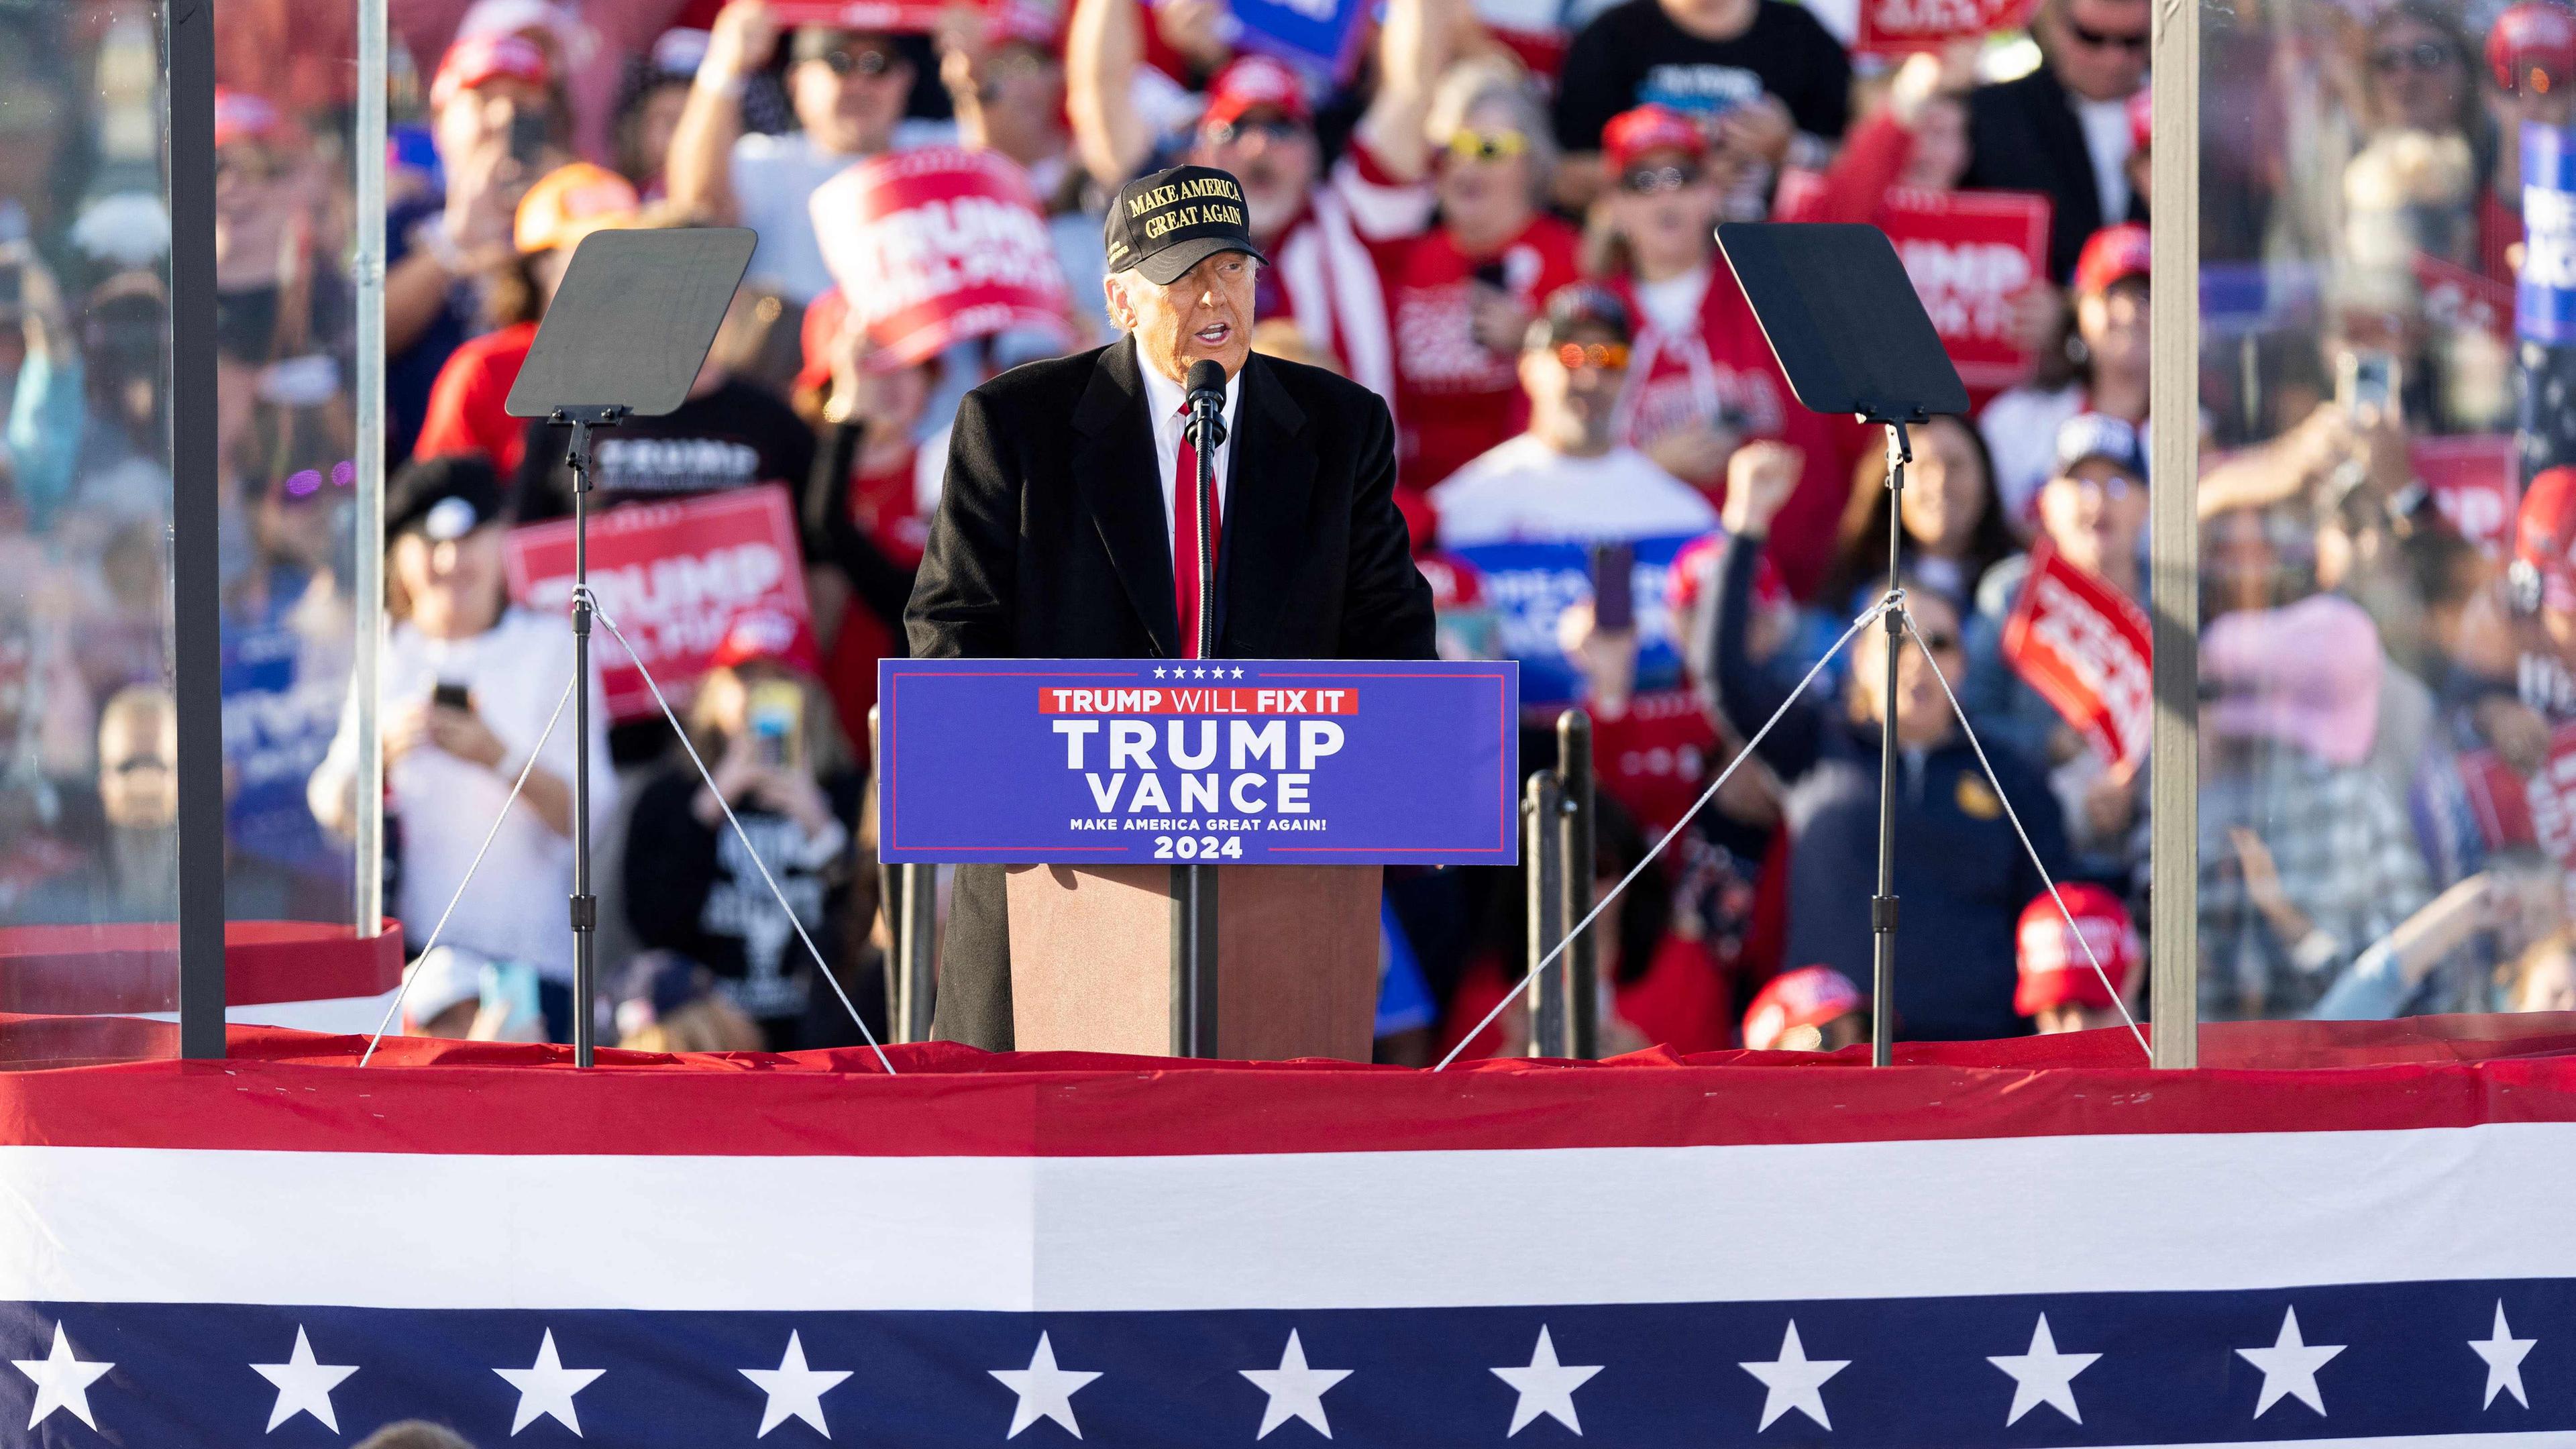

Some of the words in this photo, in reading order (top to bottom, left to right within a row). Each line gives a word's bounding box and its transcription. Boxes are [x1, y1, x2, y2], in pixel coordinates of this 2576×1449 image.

[1128, 184, 1179, 218] MAKE
[1181, 178, 1242, 202] AMERICA
[1145, 207, 1198, 239] GREAT
[1202, 204, 1242, 226] AGAIN
[1053, 690, 1163, 712] TRUMP
[1171, 690, 1248, 712] WILL
[1257, 690, 1308, 712] FIX
[1316, 690, 1345, 713] IT
[1052, 720, 1346, 770] TRUMP
[1085, 772, 1311, 814] VANCE
[1070, 818, 1118, 830] MAKE
[1123, 818, 1201, 830] AMERICA
[1206, 818, 1262, 830] GREAT
[1267, 818, 1326, 831] AGAIN!
[1153, 836, 1243, 859] 2024
